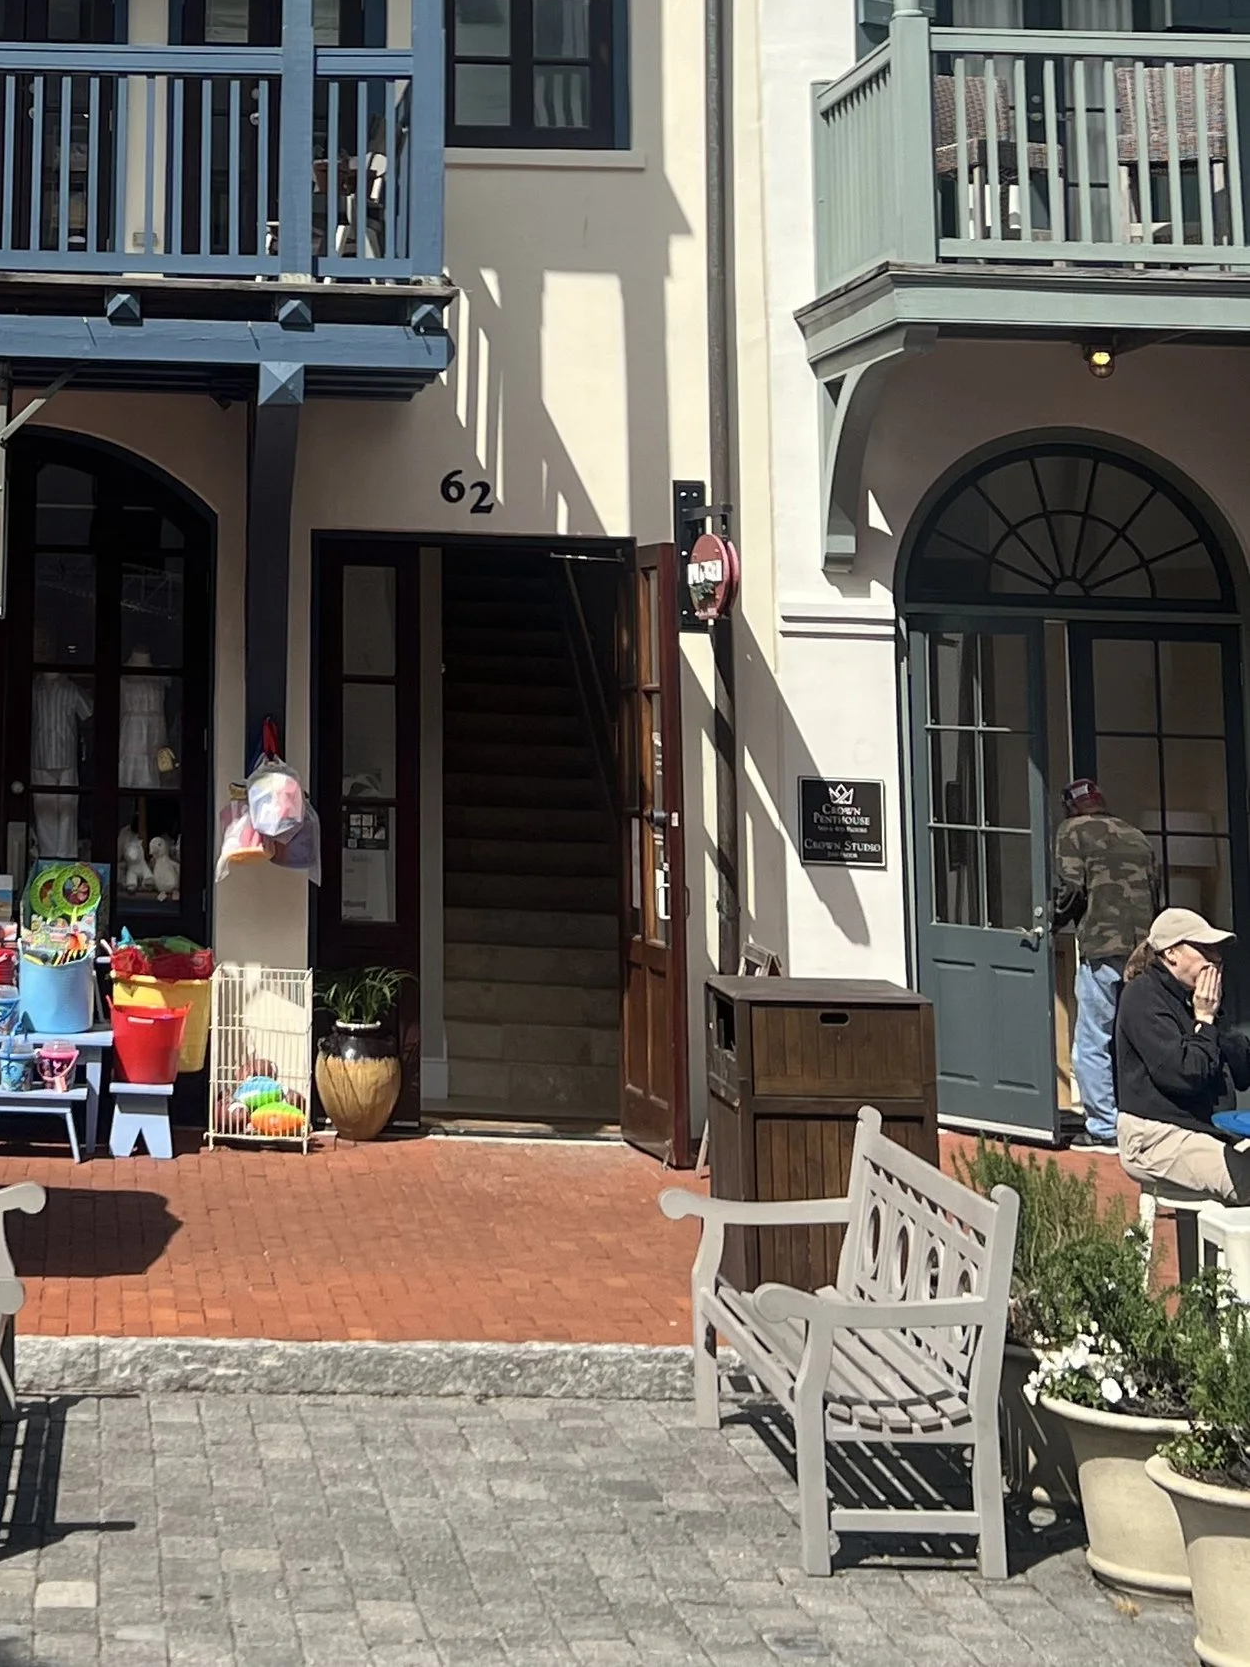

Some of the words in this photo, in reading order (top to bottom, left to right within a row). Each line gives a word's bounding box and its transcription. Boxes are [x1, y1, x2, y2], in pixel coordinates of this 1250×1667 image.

[439, 469, 494, 514] 62
[822, 803, 861, 815] CROWN
[813, 811, 870, 826] PENTHOUSE
[844, 840, 881, 852] STUDIO
